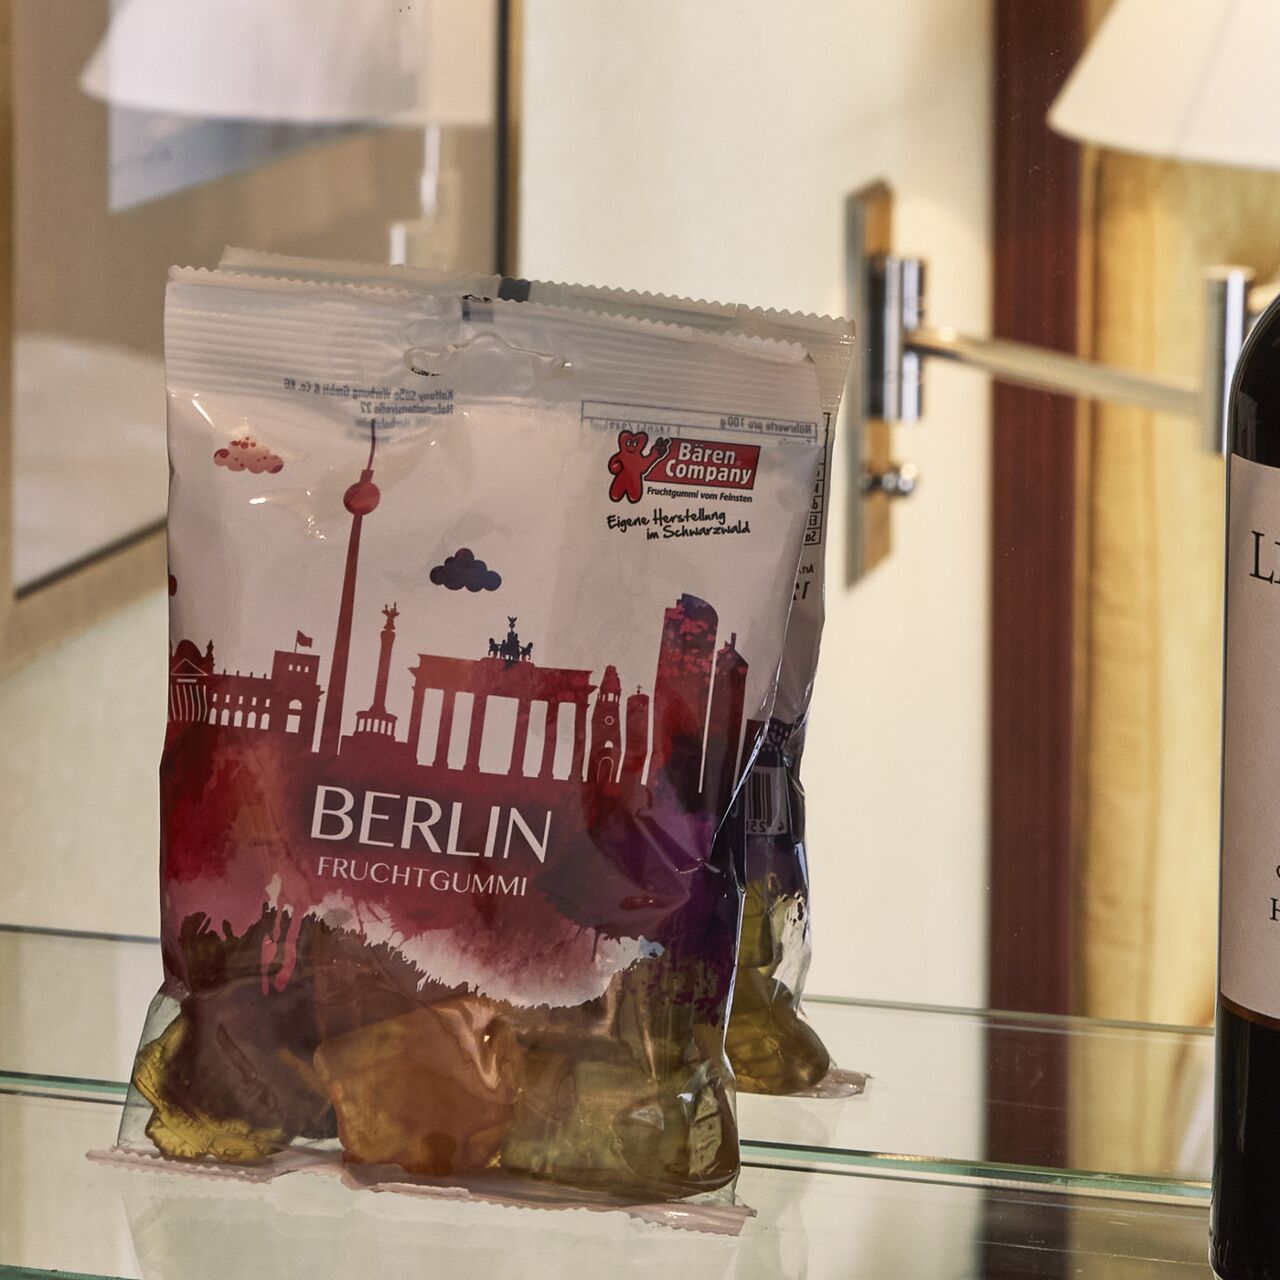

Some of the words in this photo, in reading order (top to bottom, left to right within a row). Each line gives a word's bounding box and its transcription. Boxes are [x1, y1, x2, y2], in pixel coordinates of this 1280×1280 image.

[678, 442, 737, 465] Bären
[665, 458, 753, 485] Company
[646, 486, 699, 500] Fruchtgummi
[700, 493, 719, 501] vom
[719, 492, 753, 504] Feinsten
[606, 513, 650, 533] Eigene
[653, 507, 727, 525] Herstellung
[646, 527, 660, 541] im
[663, 520, 751, 539] Schwarzwald
[310, 784, 553, 864] BERLIN
[317, 856, 528, 897] FRUCHTGUMMI
